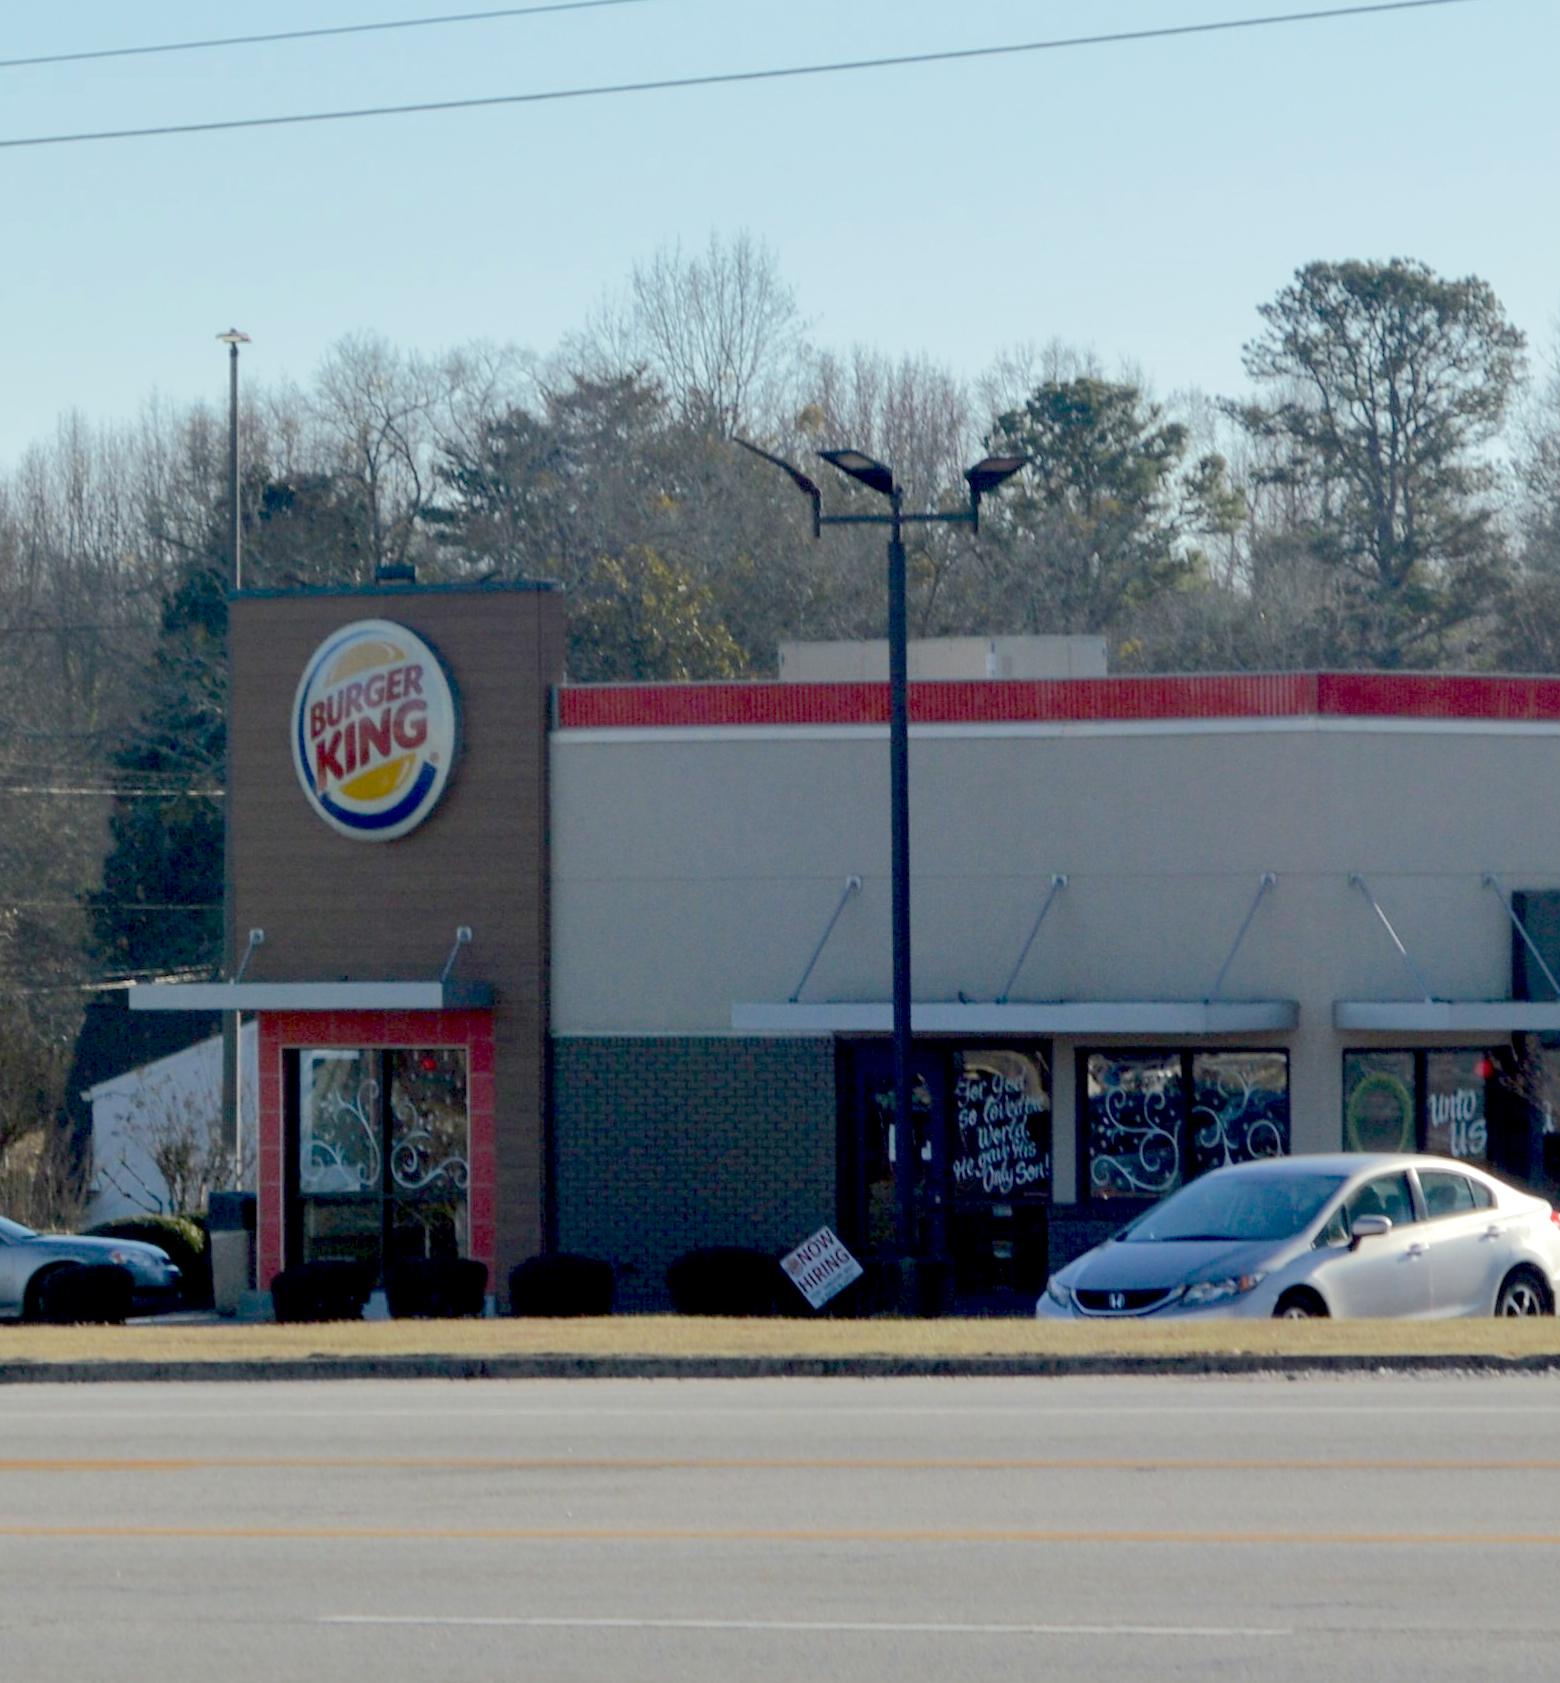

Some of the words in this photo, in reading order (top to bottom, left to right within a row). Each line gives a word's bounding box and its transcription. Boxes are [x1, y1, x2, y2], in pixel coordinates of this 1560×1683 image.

[310, 664, 424, 741] BURGER
[315, 698, 428, 793] KING
[796, 1229, 834, 1266] NOW
[797, 1247, 851, 1294] HIRING
